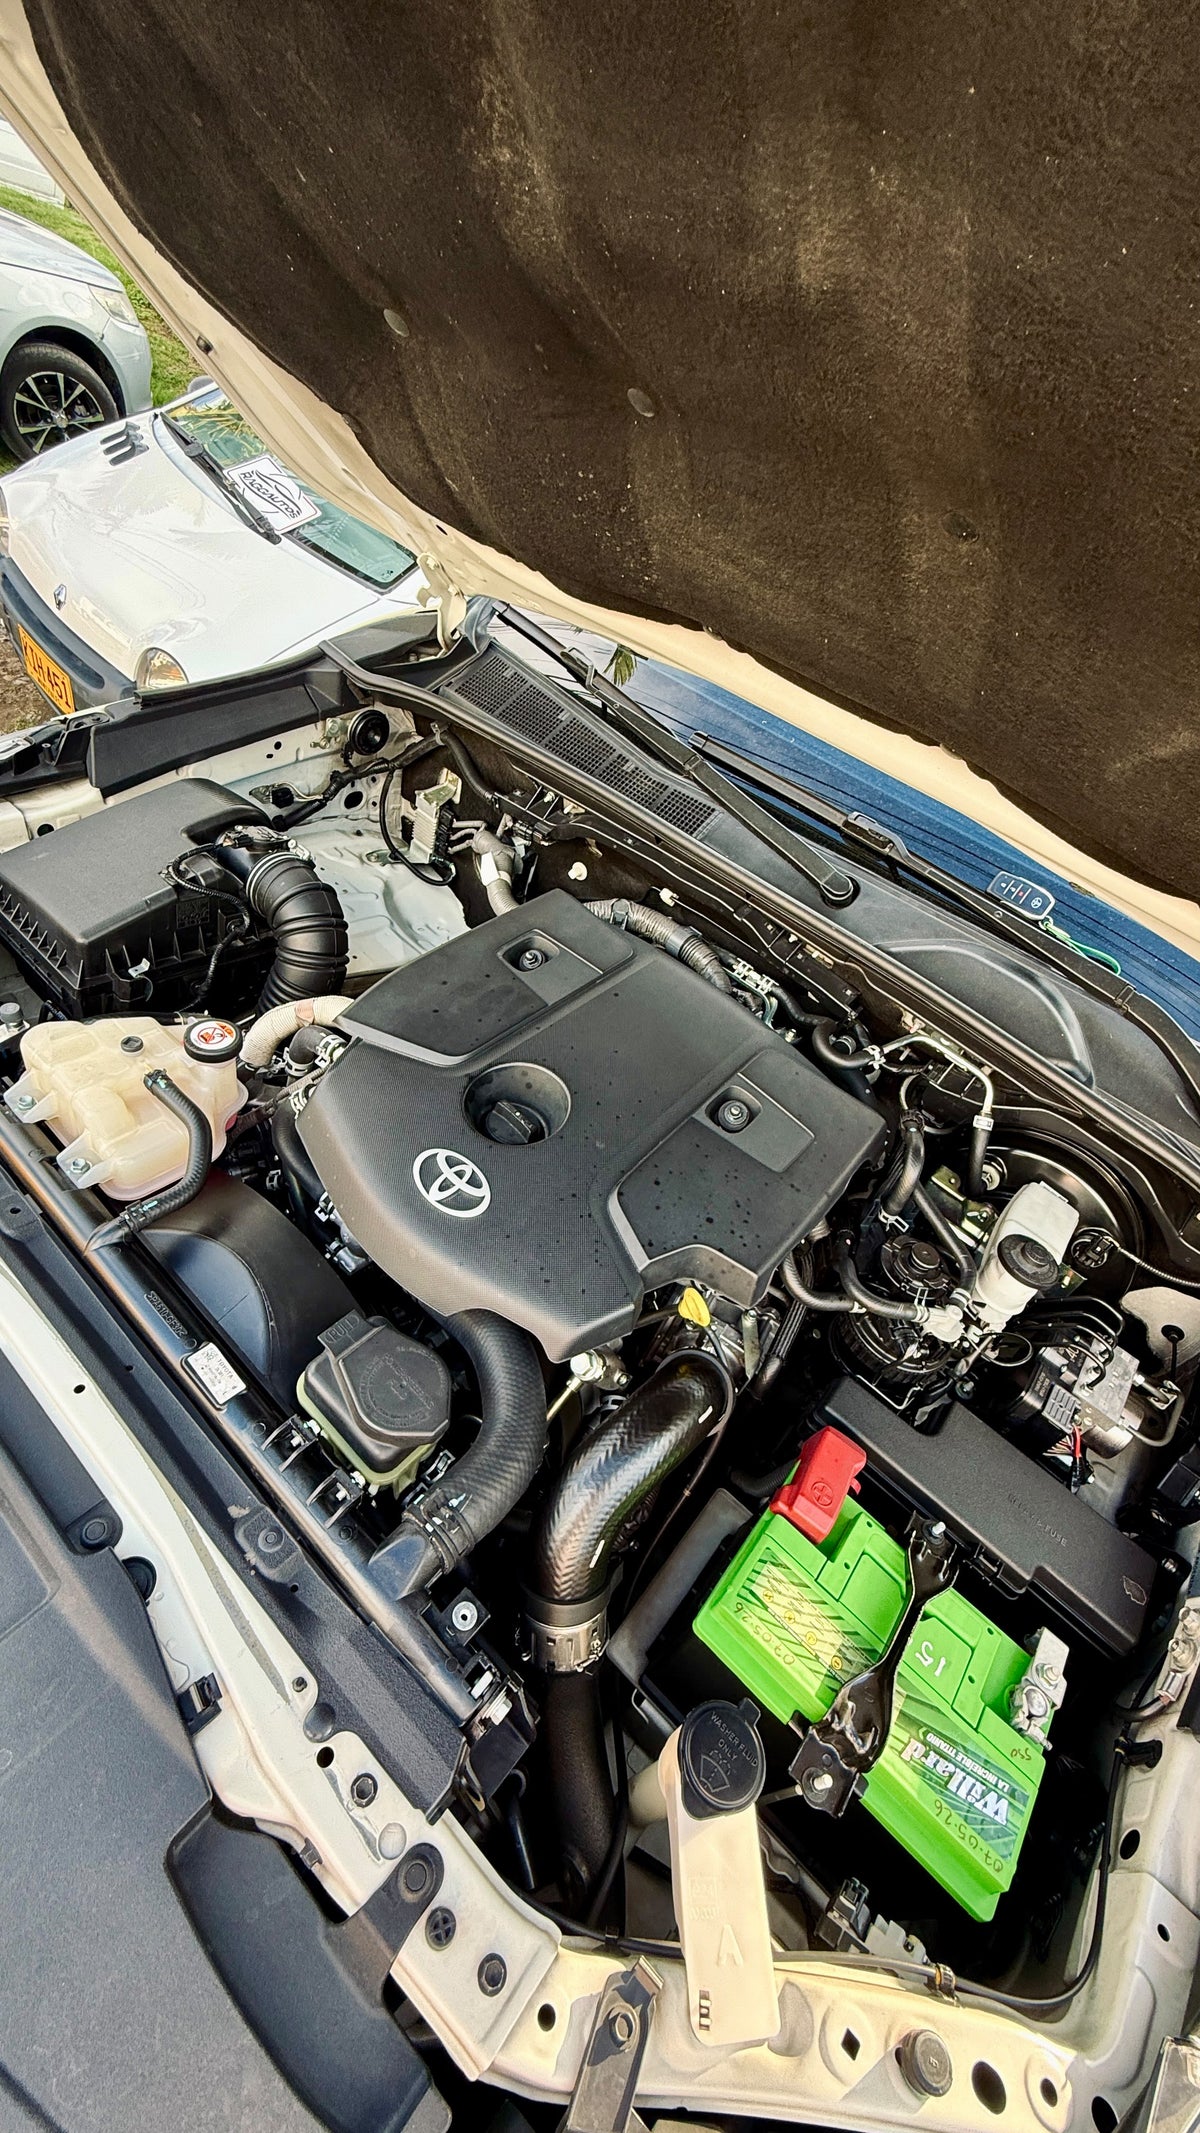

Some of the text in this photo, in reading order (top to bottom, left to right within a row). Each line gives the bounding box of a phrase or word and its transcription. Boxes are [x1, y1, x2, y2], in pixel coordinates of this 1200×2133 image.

[239, 470, 301, 519] RAGGAUTOS
[327, 1317, 355, 1342] PULL
[217, 1358, 234, 1379] TOYOTA
[1044, 1524, 1067, 1547] FUSE
[914, 1641, 947, 1677] 15
[711, 1711, 758, 1767] WASHER FLUID
[718, 1738, 738, 1761] ONLY
[926, 1732, 957, 1757] TITANIO
[901, 1738, 1009, 1826] Willard
[996, 1779, 1010, 1793] LA
[717, 1924, 744, 1967] A
